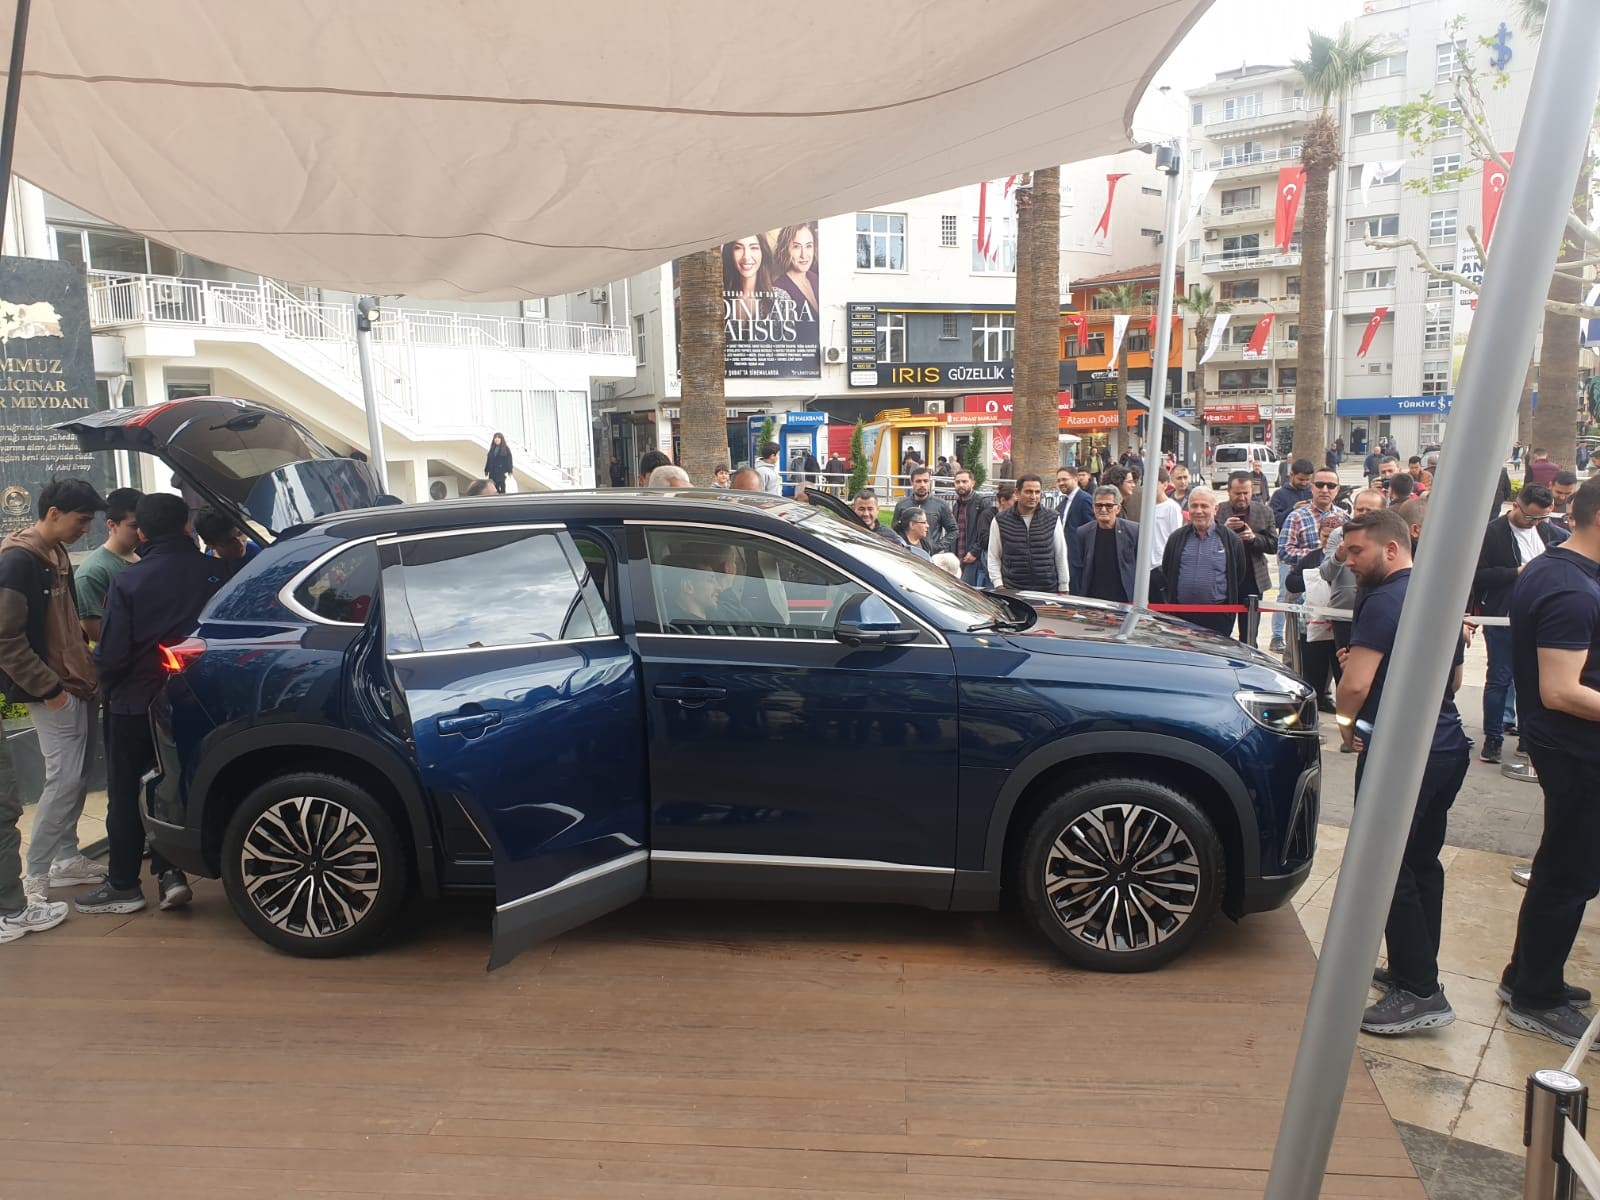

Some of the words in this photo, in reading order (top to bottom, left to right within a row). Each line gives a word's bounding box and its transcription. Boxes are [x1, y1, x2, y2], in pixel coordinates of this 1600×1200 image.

[892, 367, 940, 384] IRIS
[948, 365, 1005, 381] GÜZELLİK
[11, 396, 90, 409] MEYDANI
[1398, 399, 1436, 409] TÜRKİYE
[1067, 416, 1096, 425] Atasun
